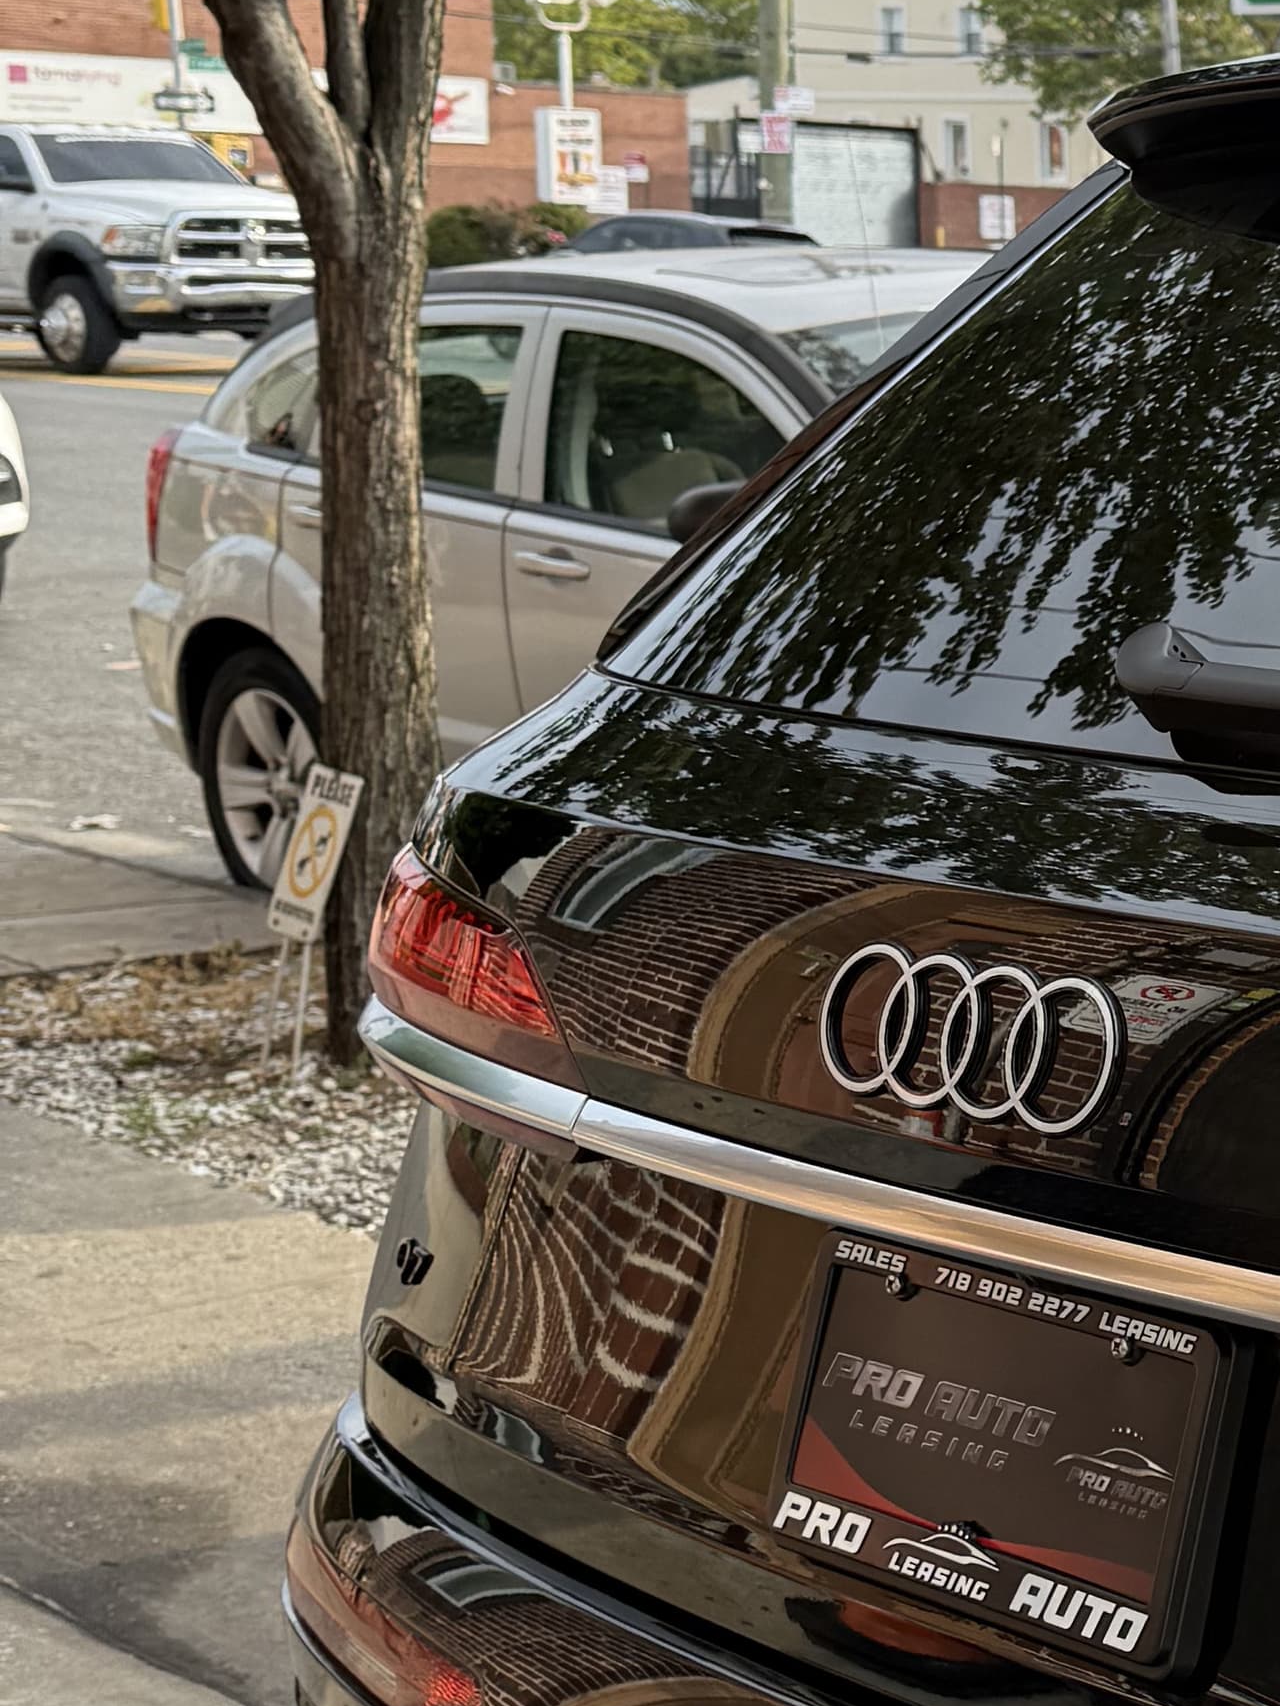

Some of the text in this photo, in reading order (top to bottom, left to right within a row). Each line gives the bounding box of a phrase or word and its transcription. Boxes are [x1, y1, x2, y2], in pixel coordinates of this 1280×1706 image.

[311, 774, 356, 808] PLEASE
[835, 1239, 1198, 1355] SALES 718 902 2277 LEASING
[822, 1351, 1057, 1448] PRO AUTO
[849, 1408, 1009, 1472] LEASING
[1065, 1465, 1170, 1510] PRO AUTO
[771, 1490, 873, 1555] PRO
[887, 1550, 991, 1603] LEASING
[1007, 1572, 1150, 1654] AUTO
